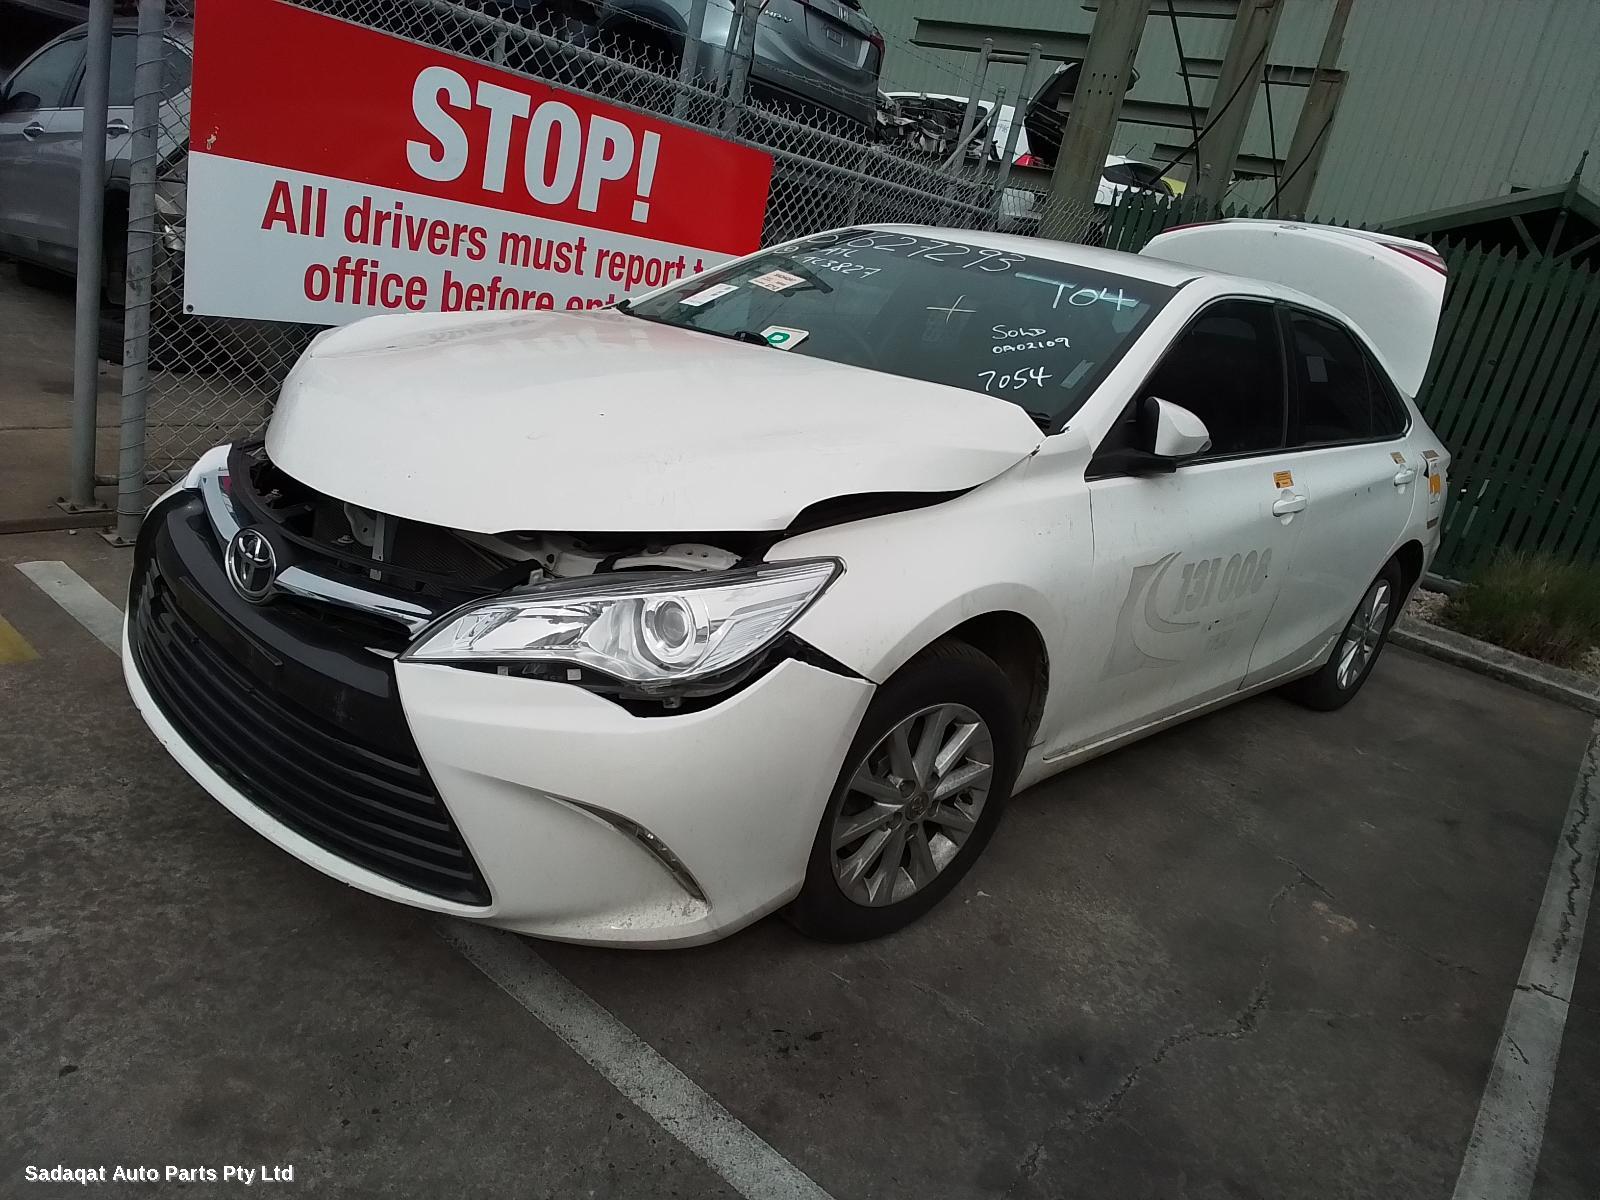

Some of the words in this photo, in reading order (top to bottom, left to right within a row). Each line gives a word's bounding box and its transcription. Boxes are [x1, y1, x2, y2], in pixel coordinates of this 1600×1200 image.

[406, 66, 661, 224] STOP!
[261, 180, 328, 238] All
[344, 196, 487, 261] drivers
[498, 231, 587, 276] must
[594, 248, 686, 291] report
[304, 256, 427, 311] office
[441, 270, 554, 312] before
[978, 366, 1053, 392] 7054
